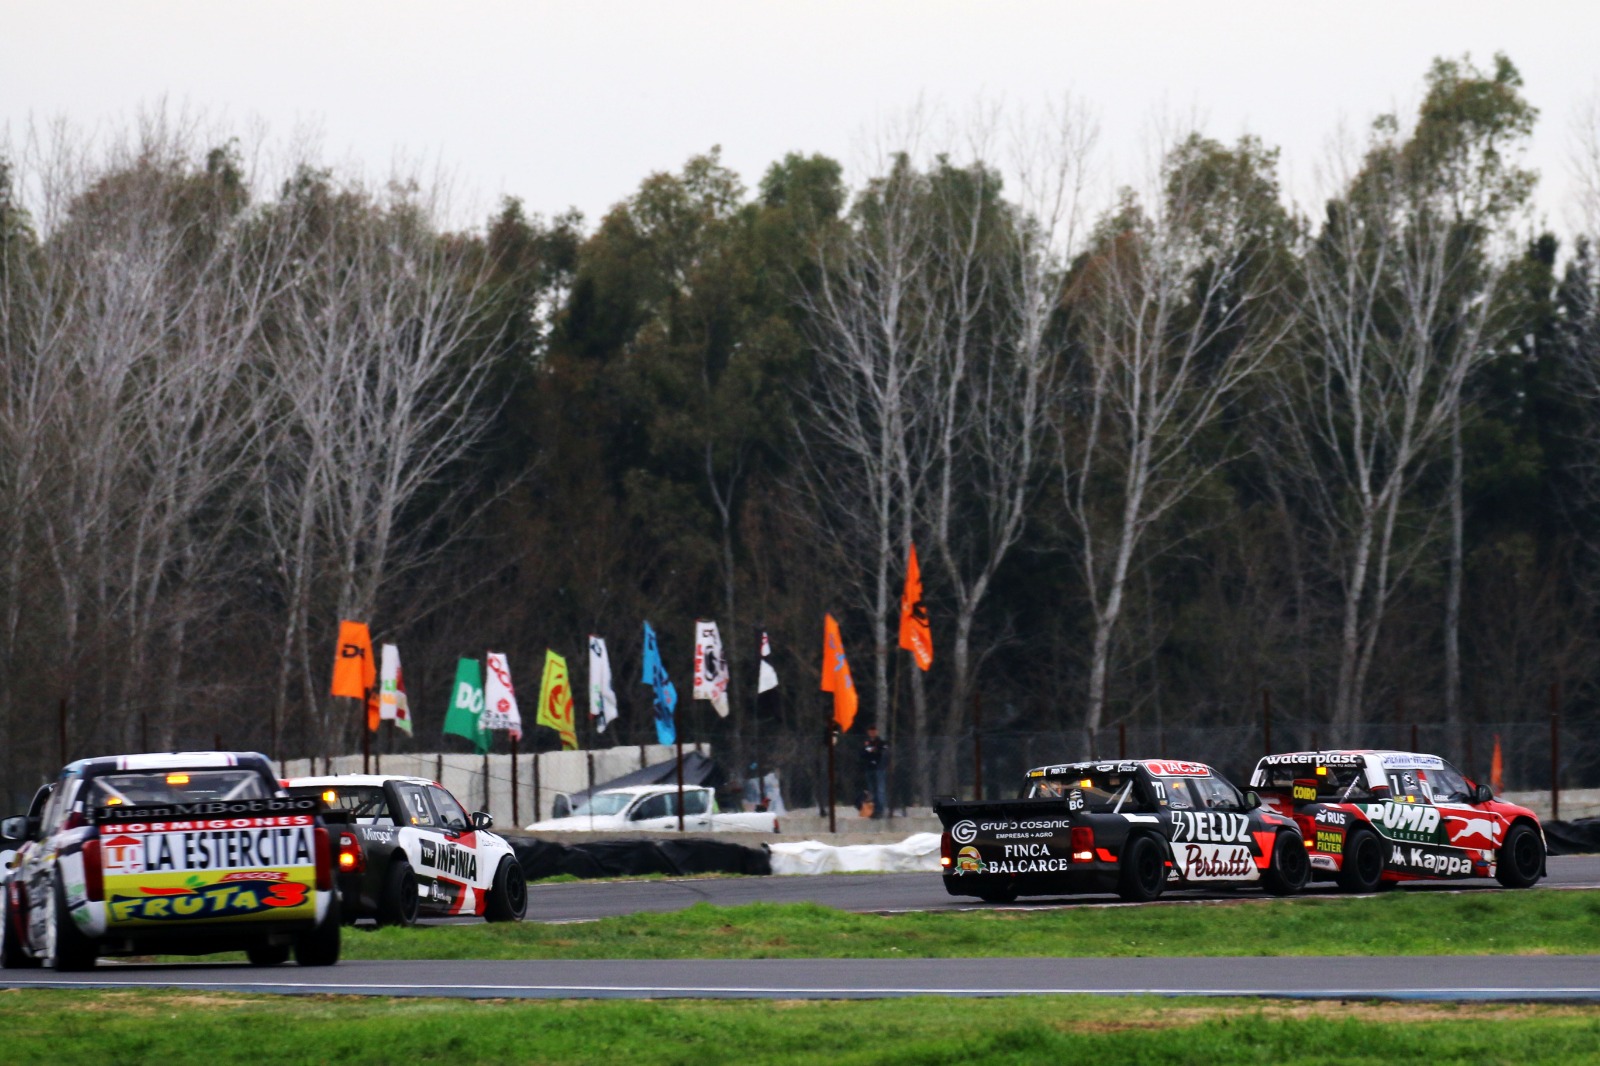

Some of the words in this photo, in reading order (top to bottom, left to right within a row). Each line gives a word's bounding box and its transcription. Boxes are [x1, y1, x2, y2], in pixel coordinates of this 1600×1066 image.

[1265, 754, 1358, 767] waterplast
[1293, 785, 1317, 801] COIRO
[1390, 774, 1400, 796] 1
[414, 793, 424, 813] 2
[1069, 799, 1084, 811] BC
[105, 816, 309, 833] HORMIGONES
[1326, 811, 1346, 825] RUS
[1366, 801, 1441, 834] PUMA
[1185, 810, 1252, 843] JELUZ
[1316, 831, 1342, 844] MANN
[143, 833, 175, 871] LA
[185, 828, 313, 870] ESTERCITA
[422, 846, 435, 859] YPF
[1004, 843, 1051, 858] FINCA
[1316, 841, 1342, 853] FILTER
[436, 843, 477, 882] INFINIA
[989, 858, 1068, 874] BALCARCE
[1184, 844, 1252, 878] Pertutti
[1410, 847, 1473, 876] Kappa
[112, 886, 260, 921] FRUTA
[261, 882, 307, 907] 3
